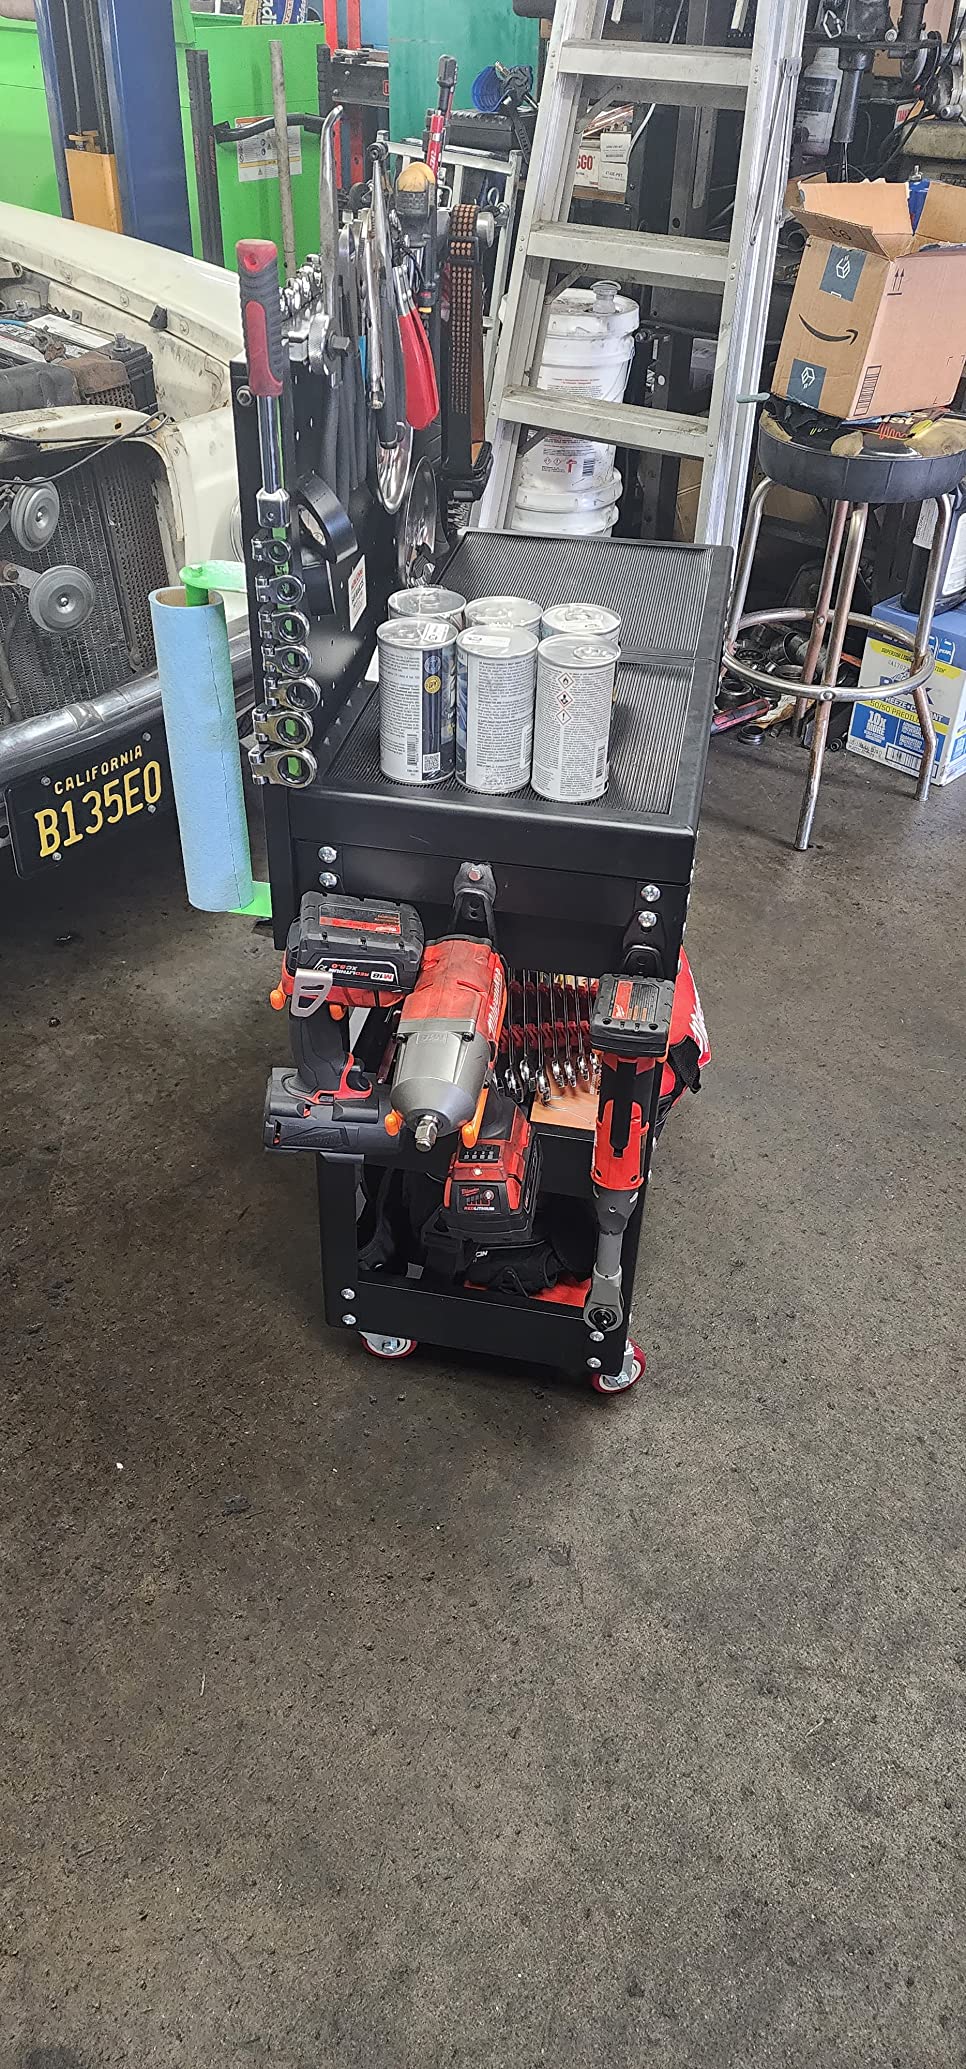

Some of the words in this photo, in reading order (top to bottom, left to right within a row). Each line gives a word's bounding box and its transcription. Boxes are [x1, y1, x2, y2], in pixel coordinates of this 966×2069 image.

[870, 699, 891, 713] 50/50
[866, 722, 886, 736] MORE
[54, 745, 143, 795] CALIFORNIA
